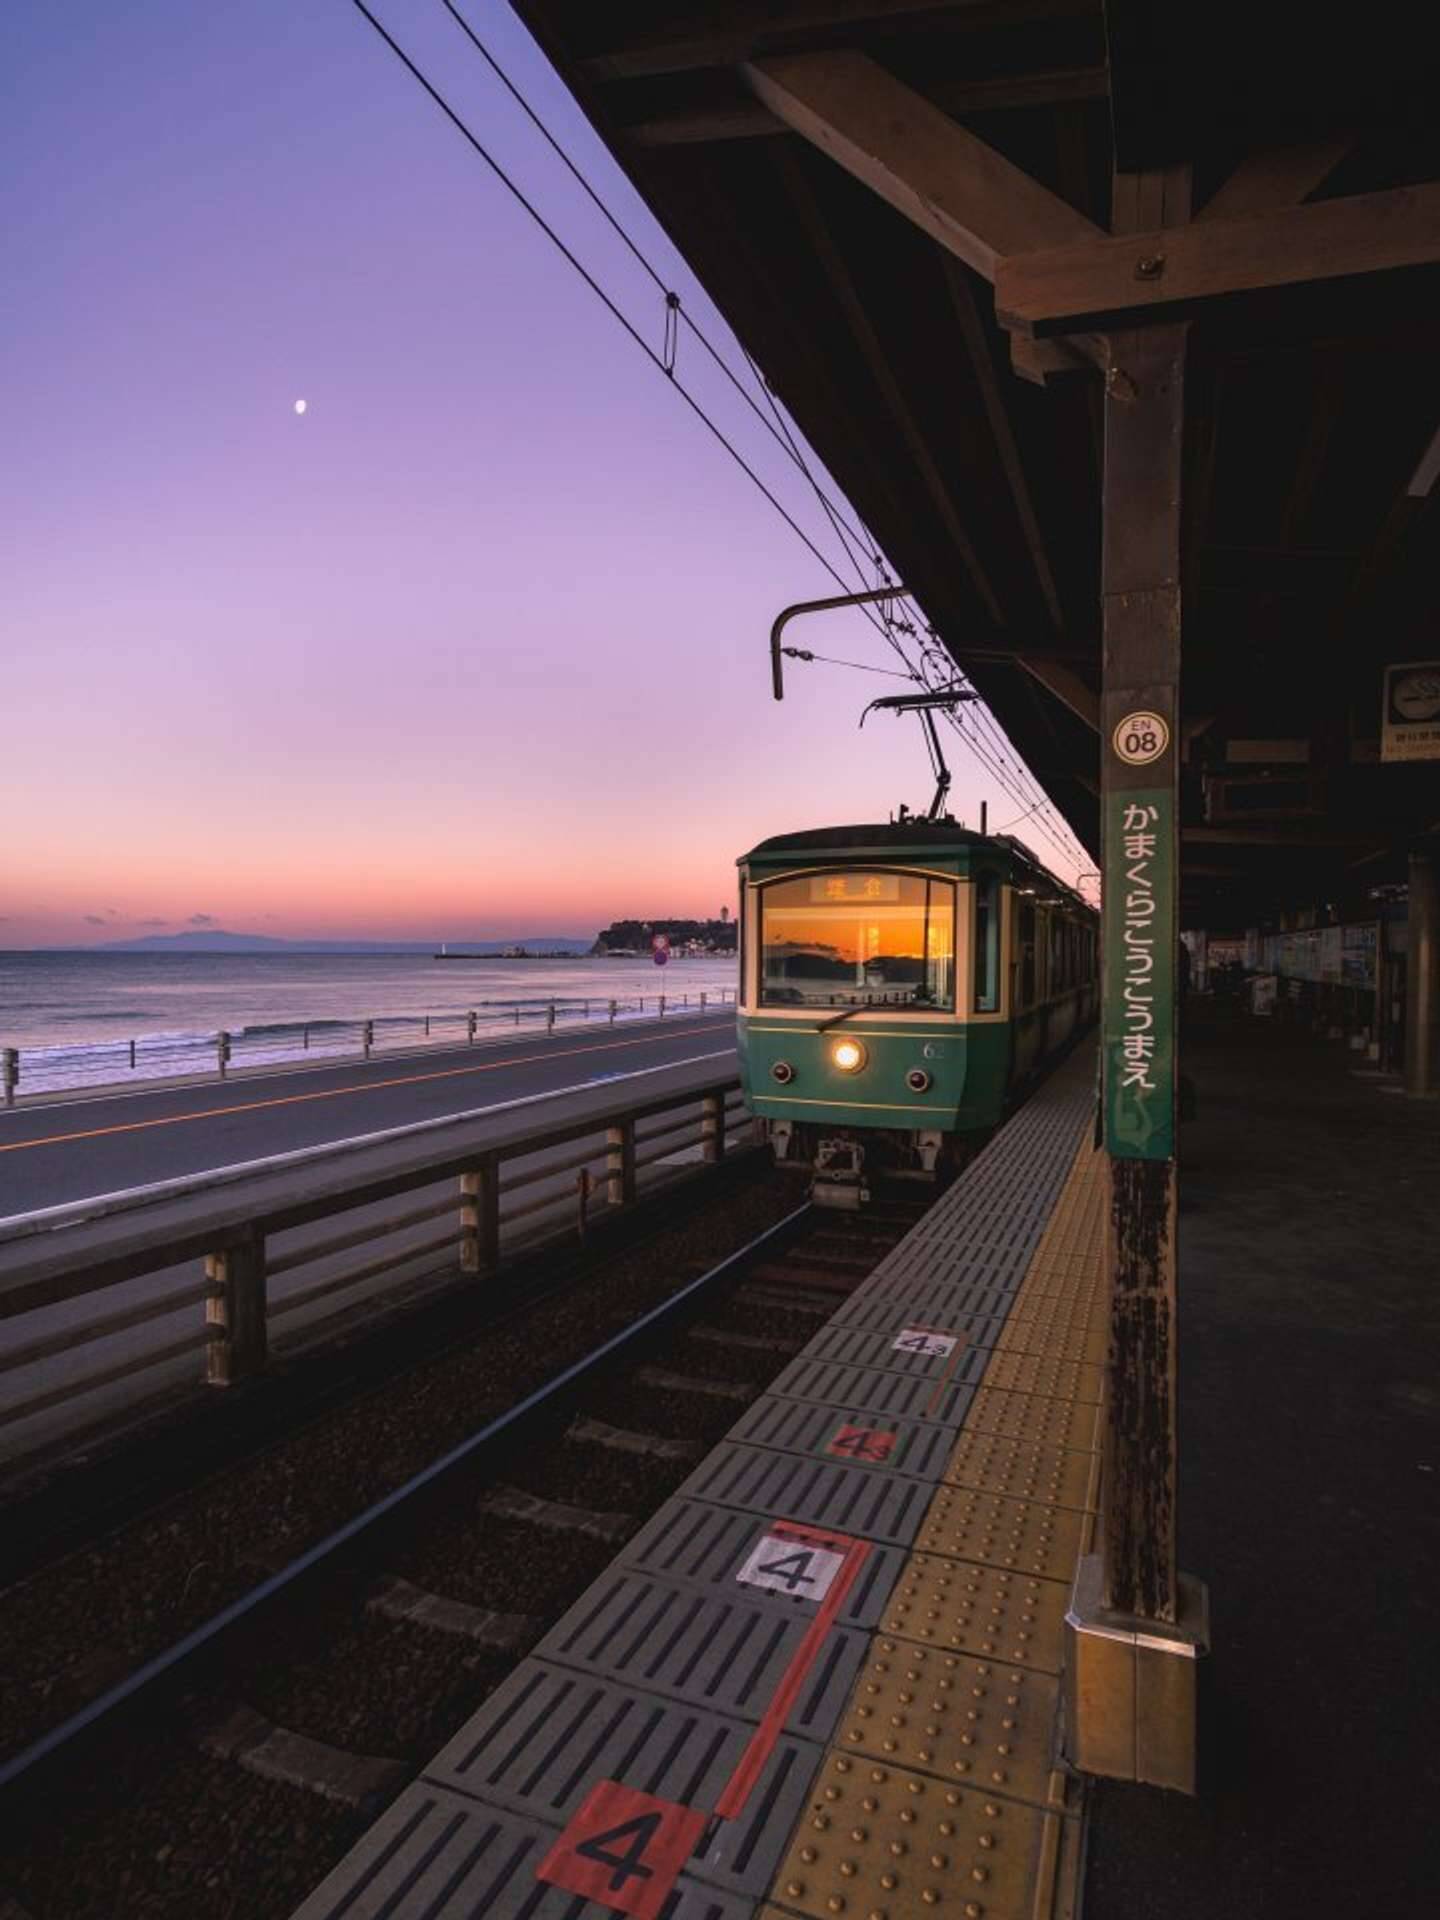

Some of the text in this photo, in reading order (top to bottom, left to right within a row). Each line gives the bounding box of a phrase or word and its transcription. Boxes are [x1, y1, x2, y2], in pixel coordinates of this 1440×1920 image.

[1125, 731, 1157, 754] 08
[1131, 719, 1151, 731] EN
[1122, 803, 1159, 1089] かまくらこうこうまえ
[757, 1550, 816, 1590] 4
[575, 1811, 663, 1892] 4
